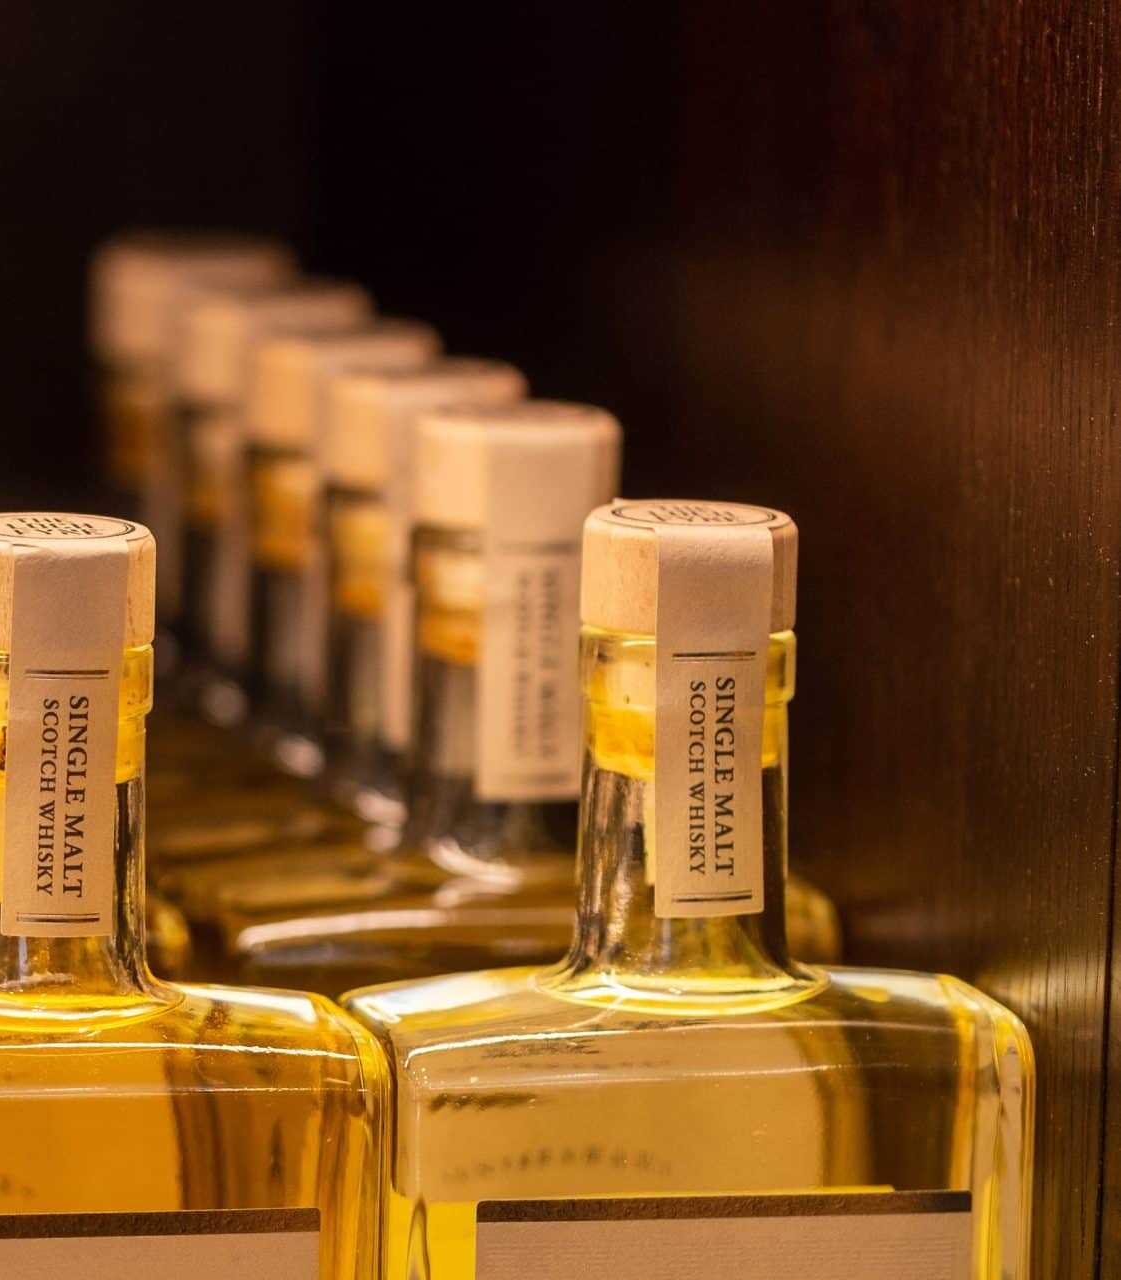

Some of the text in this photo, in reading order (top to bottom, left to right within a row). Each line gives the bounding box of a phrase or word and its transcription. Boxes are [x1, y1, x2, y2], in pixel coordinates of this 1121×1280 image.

[36, 698, 60, 897] SCOTCH WHISKY
[62, 695, 90, 899] SINGLE MALT
[688, 680, 707, 875] SCOTCH WHISKY
[714, 676, 736, 877] SINGLE MALT
